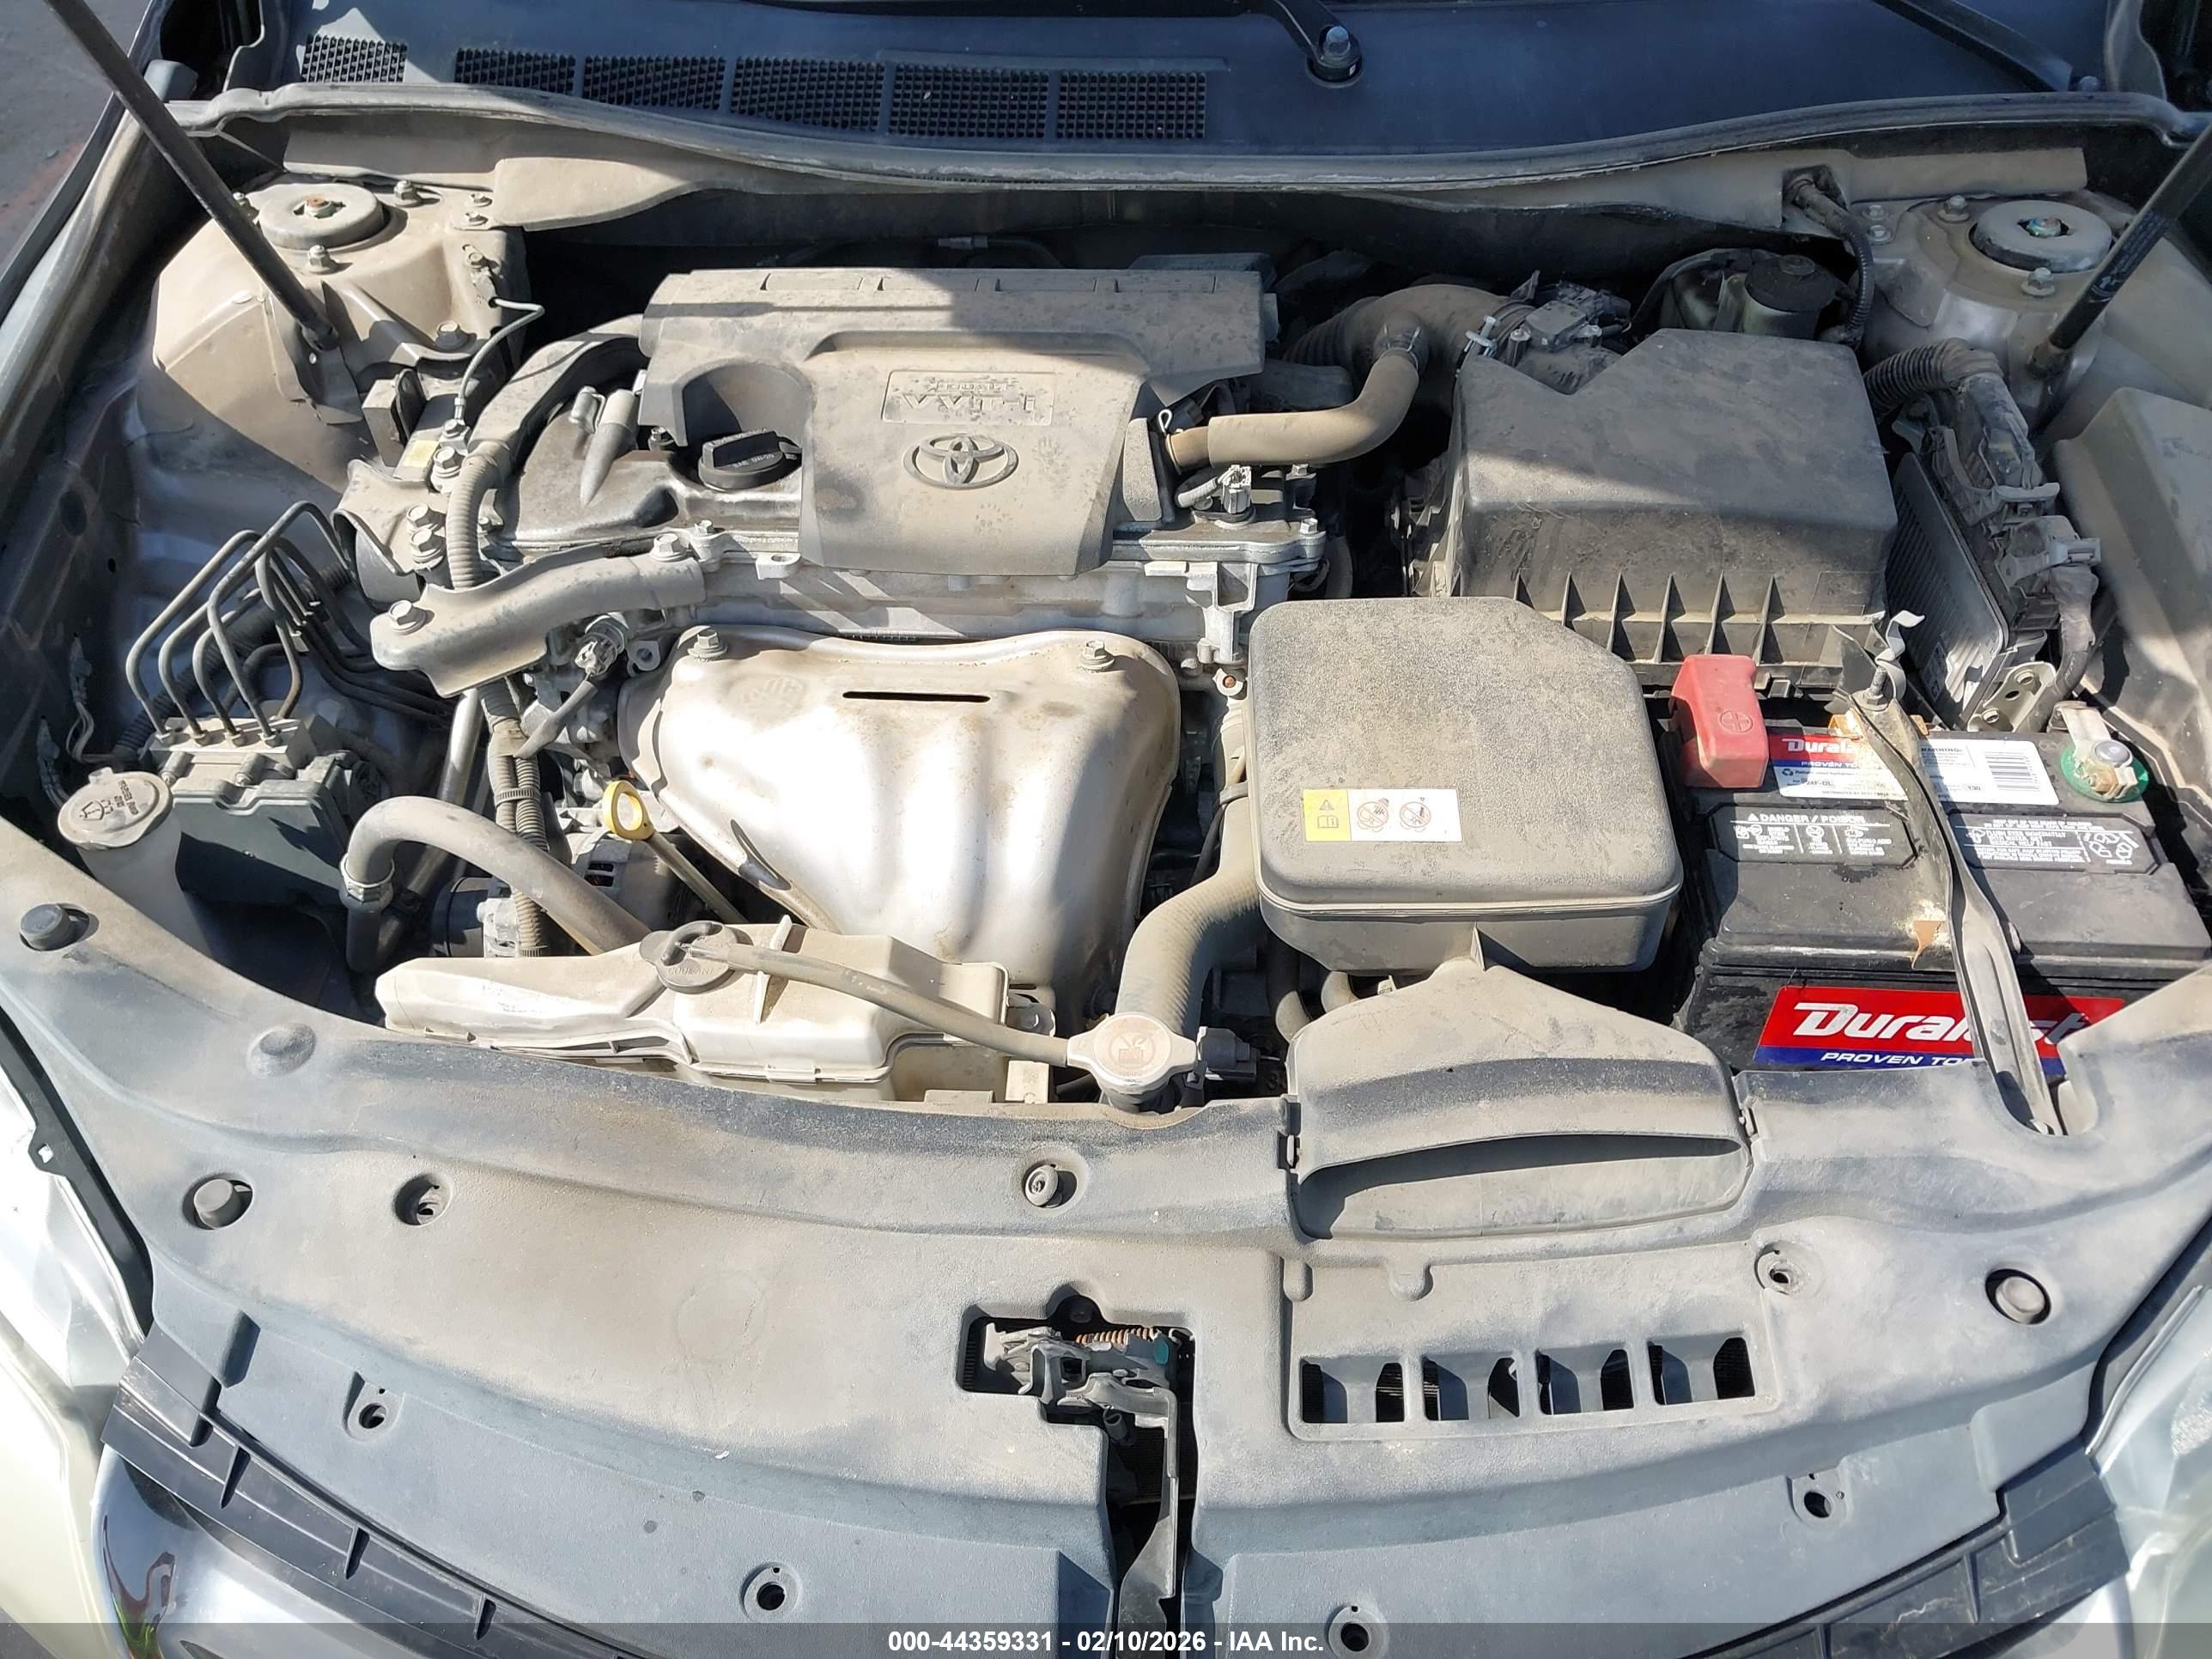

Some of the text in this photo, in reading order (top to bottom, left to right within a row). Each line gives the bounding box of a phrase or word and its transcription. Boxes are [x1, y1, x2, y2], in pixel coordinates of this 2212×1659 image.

[1759, 813, 1810, 823] DANGER
[1820, 815, 1865, 824] POISON
[1820, 1052, 1974, 1066] PROVEN TO
